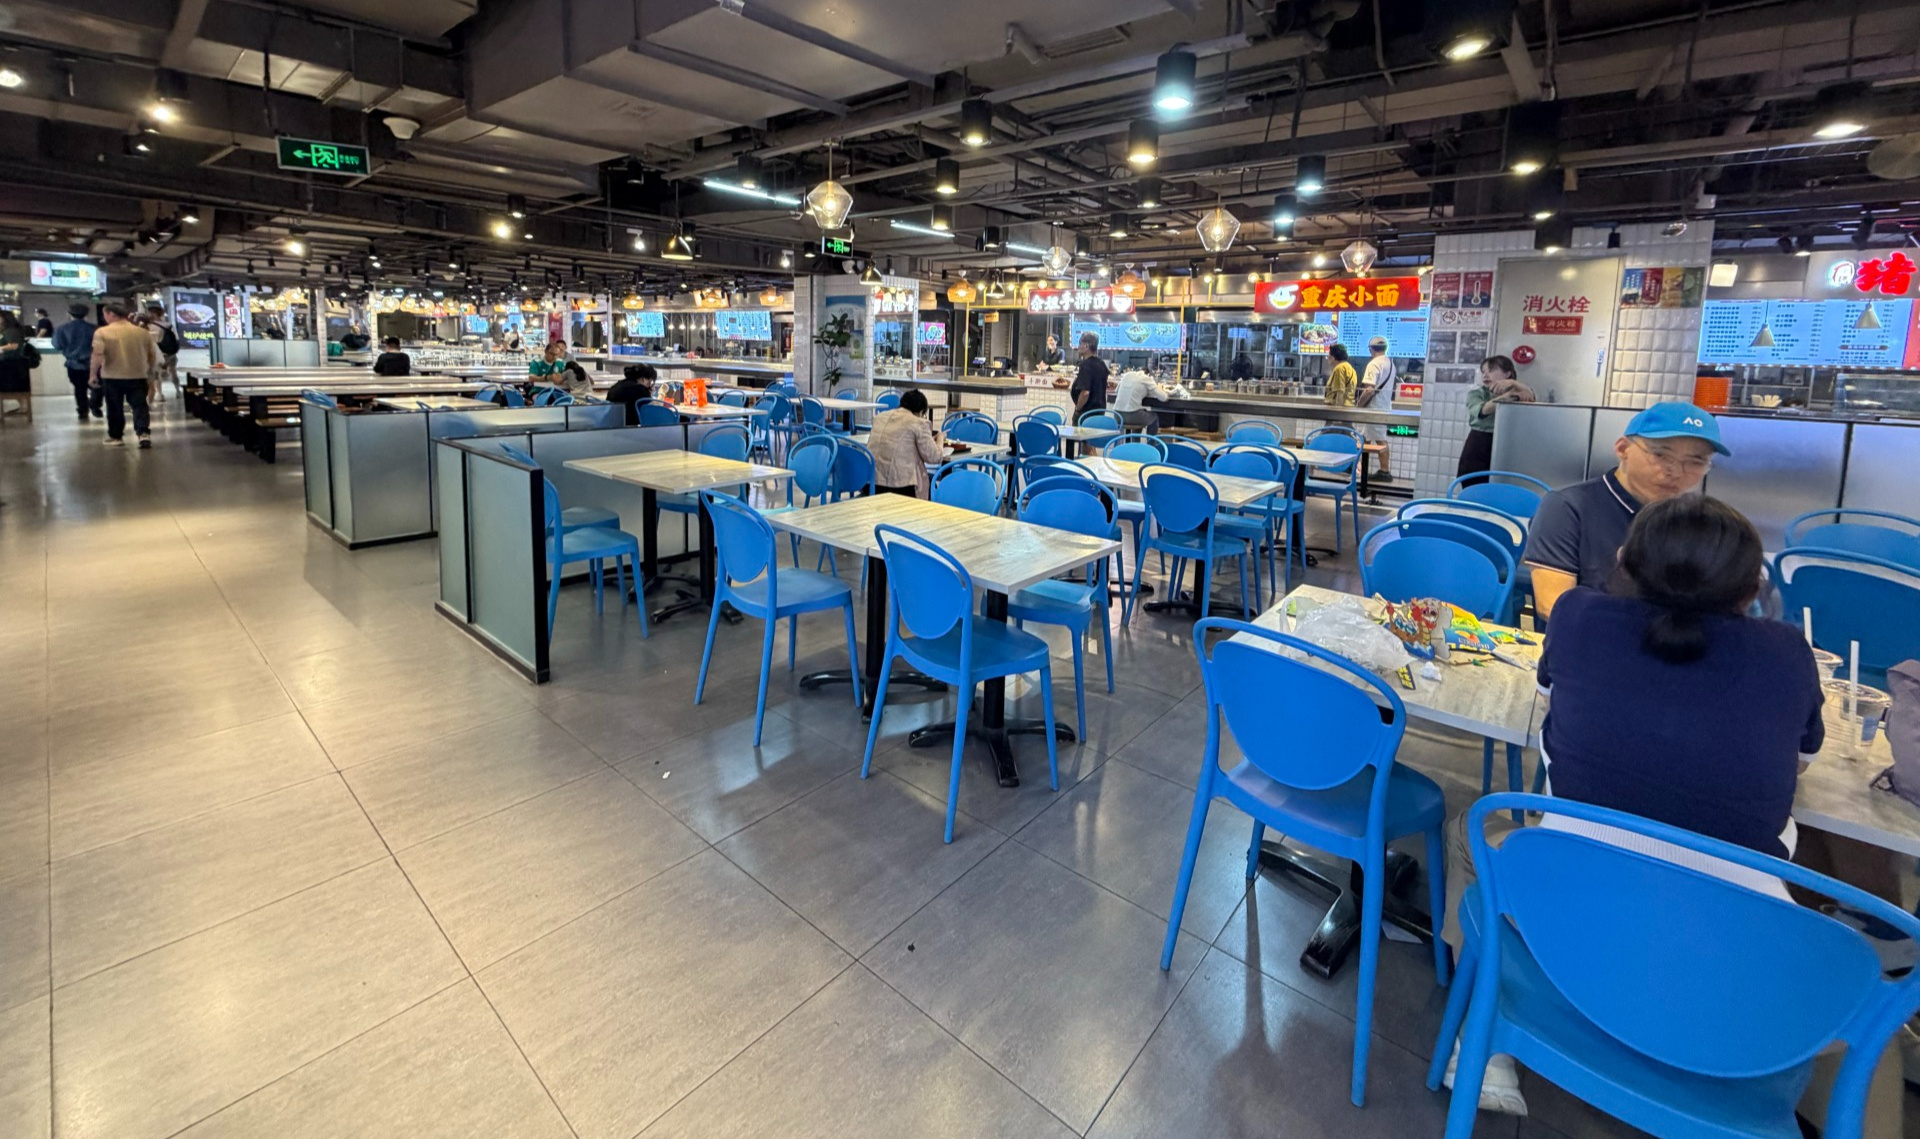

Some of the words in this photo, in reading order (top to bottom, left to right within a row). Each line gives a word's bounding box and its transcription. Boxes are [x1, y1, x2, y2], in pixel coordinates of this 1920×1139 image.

[1855, 251, 1918, 295] 猪
[1300, 284, 1400, 308] 重庆小面
[1523, 295, 1591, 313] 消火栓
[1683, 416, 1703, 428] AO
